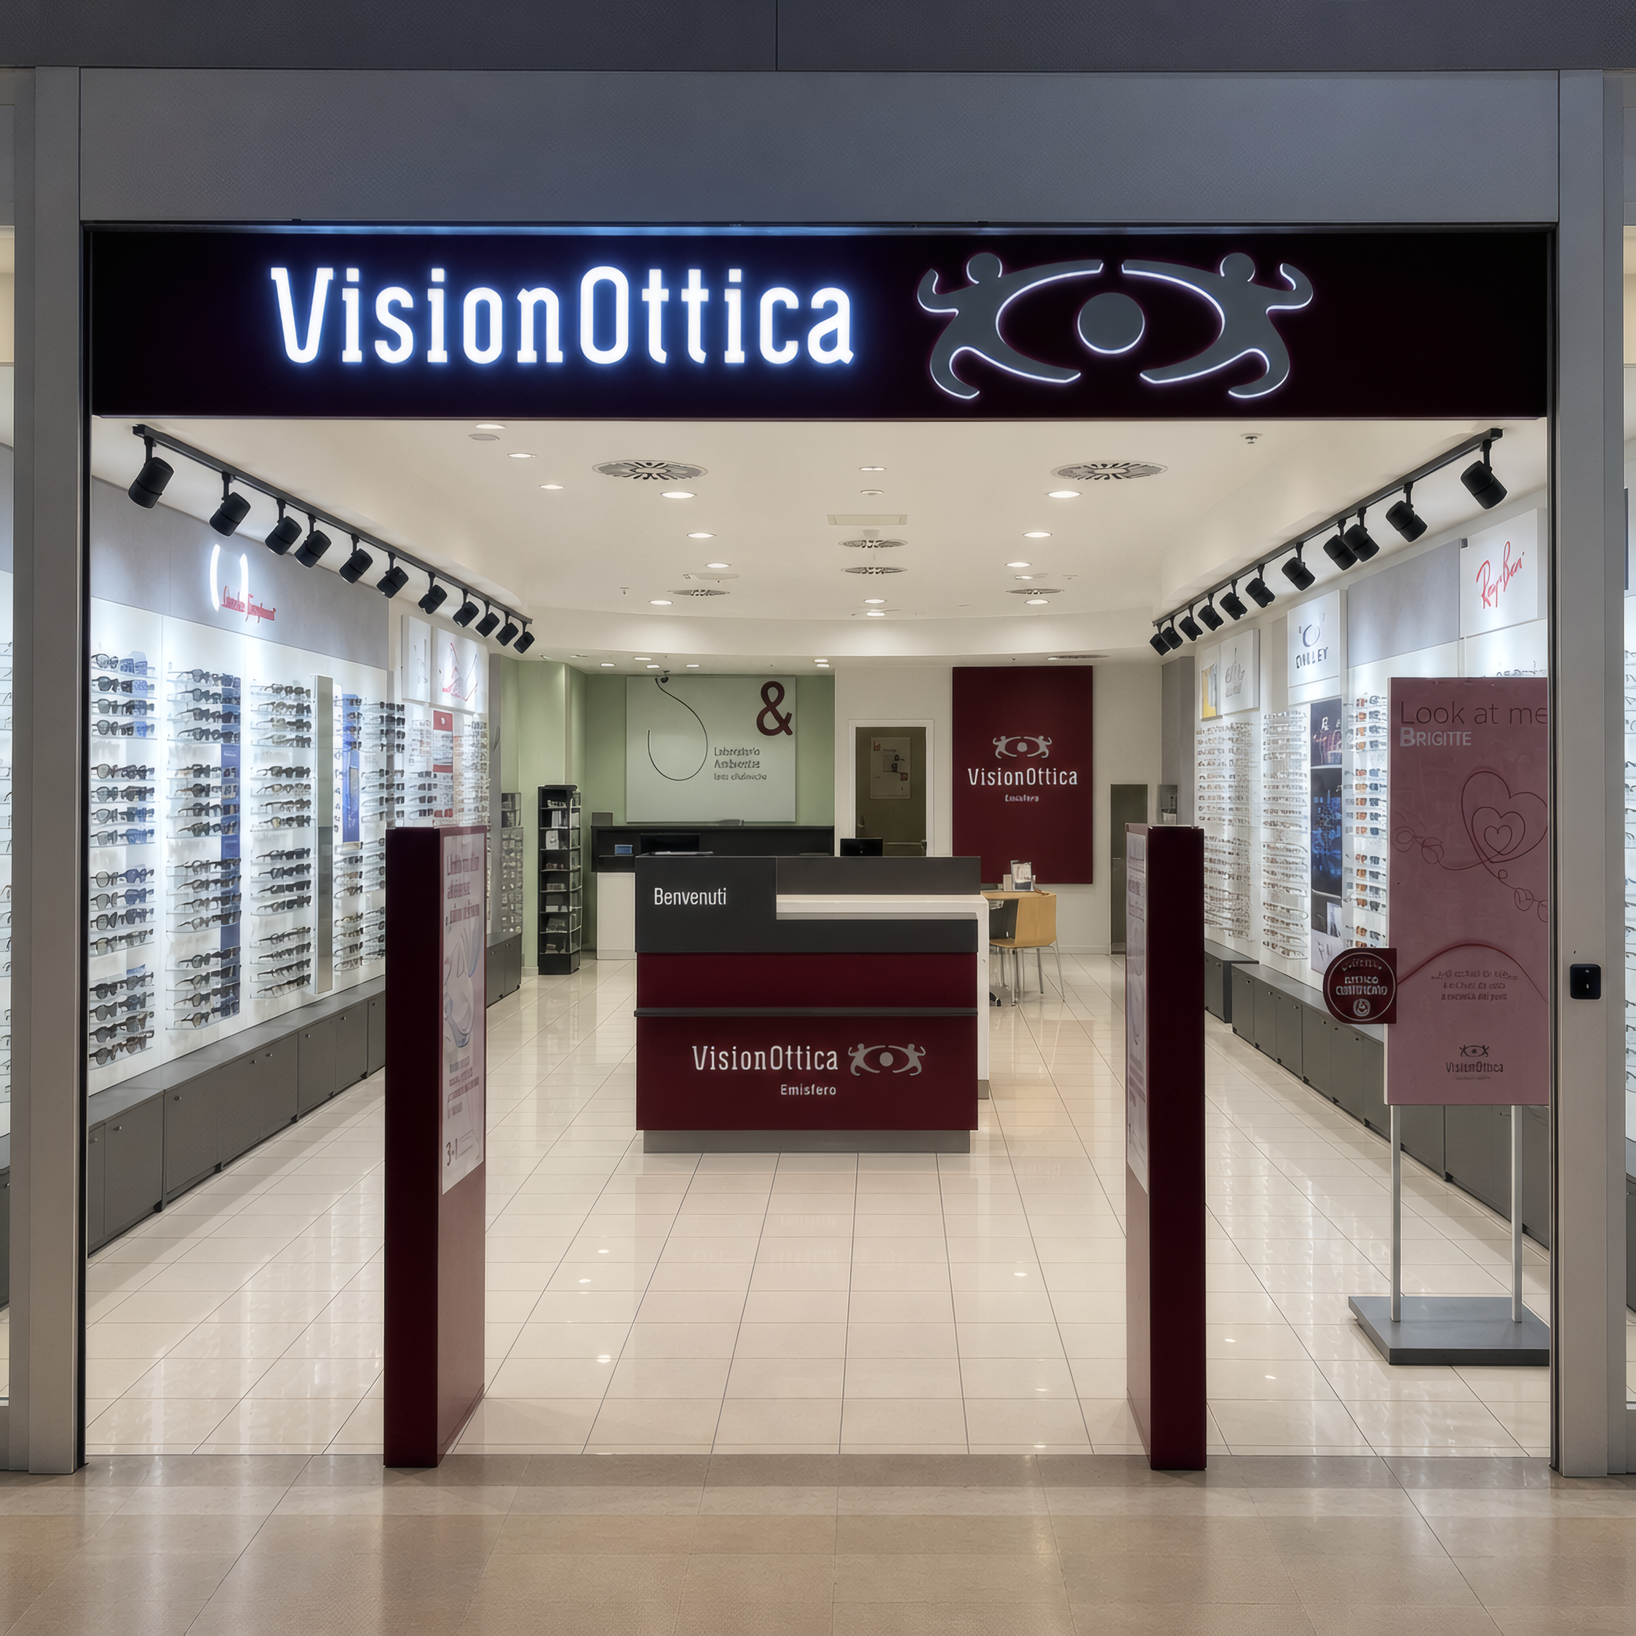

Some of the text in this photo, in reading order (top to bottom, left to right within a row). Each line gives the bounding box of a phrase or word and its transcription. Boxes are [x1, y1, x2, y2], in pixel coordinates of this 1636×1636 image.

[269, 264, 856, 366] VisionOttica
[1400, 700, 1548, 725] Look at me
[1400, 726, 1472, 747] BRIGITTE
[967, 767, 1078, 786] VisionOttica
[653, 887, 727, 906] Benvenuti
[692, 1045, 839, 1071] VisionOttica
[780, 1083, 837, 1096] Emisfero
